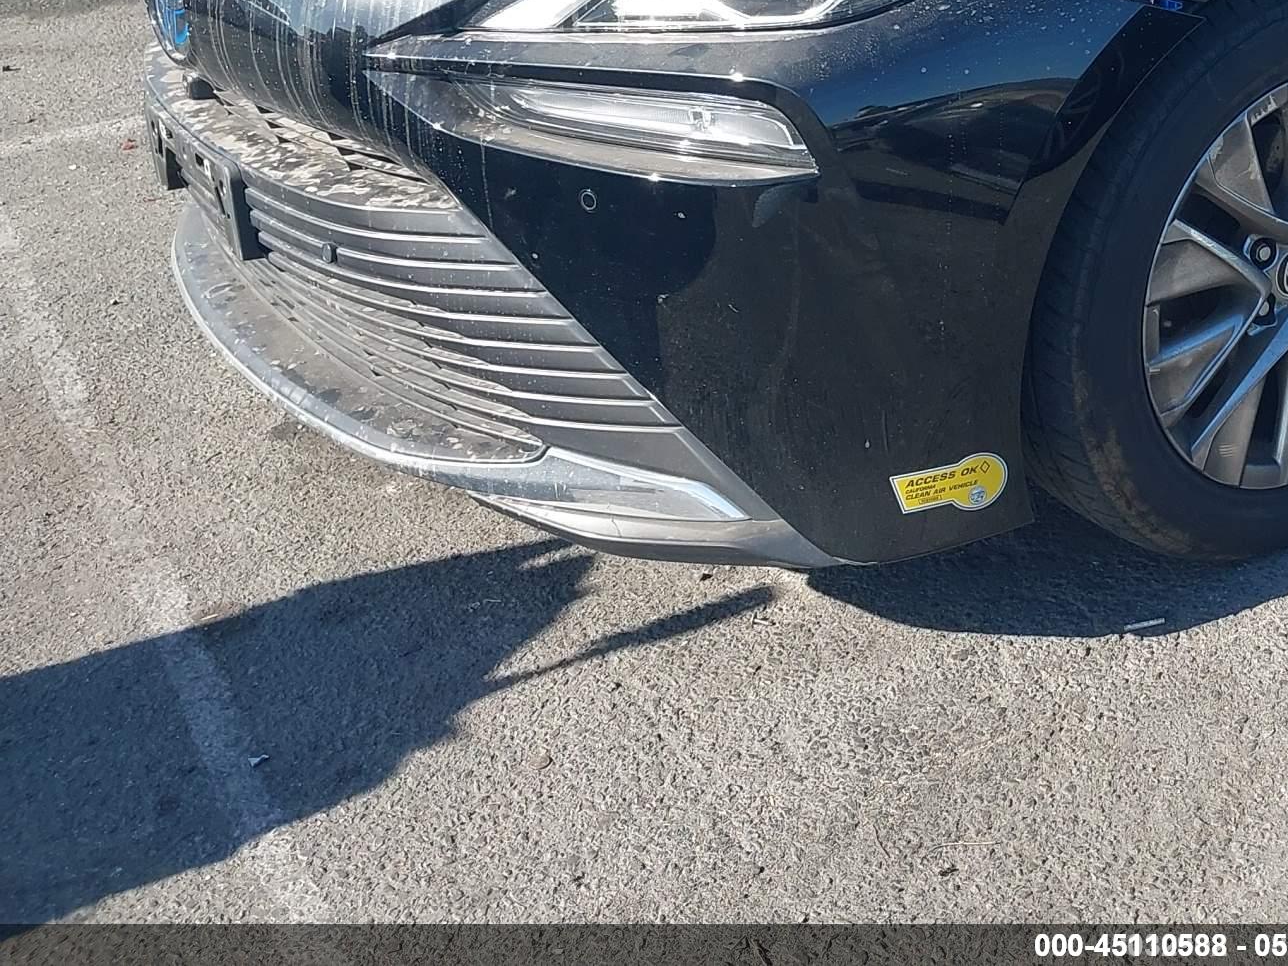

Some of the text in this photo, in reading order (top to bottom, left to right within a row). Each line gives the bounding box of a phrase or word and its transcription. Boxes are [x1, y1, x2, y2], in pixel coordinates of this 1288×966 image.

[905, 465, 980, 488] ACCESS OK
[905, 490, 931, 501] CLEAN
[933, 487, 946, 495] AIR
[948, 480, 979, 491] VEHICLE
